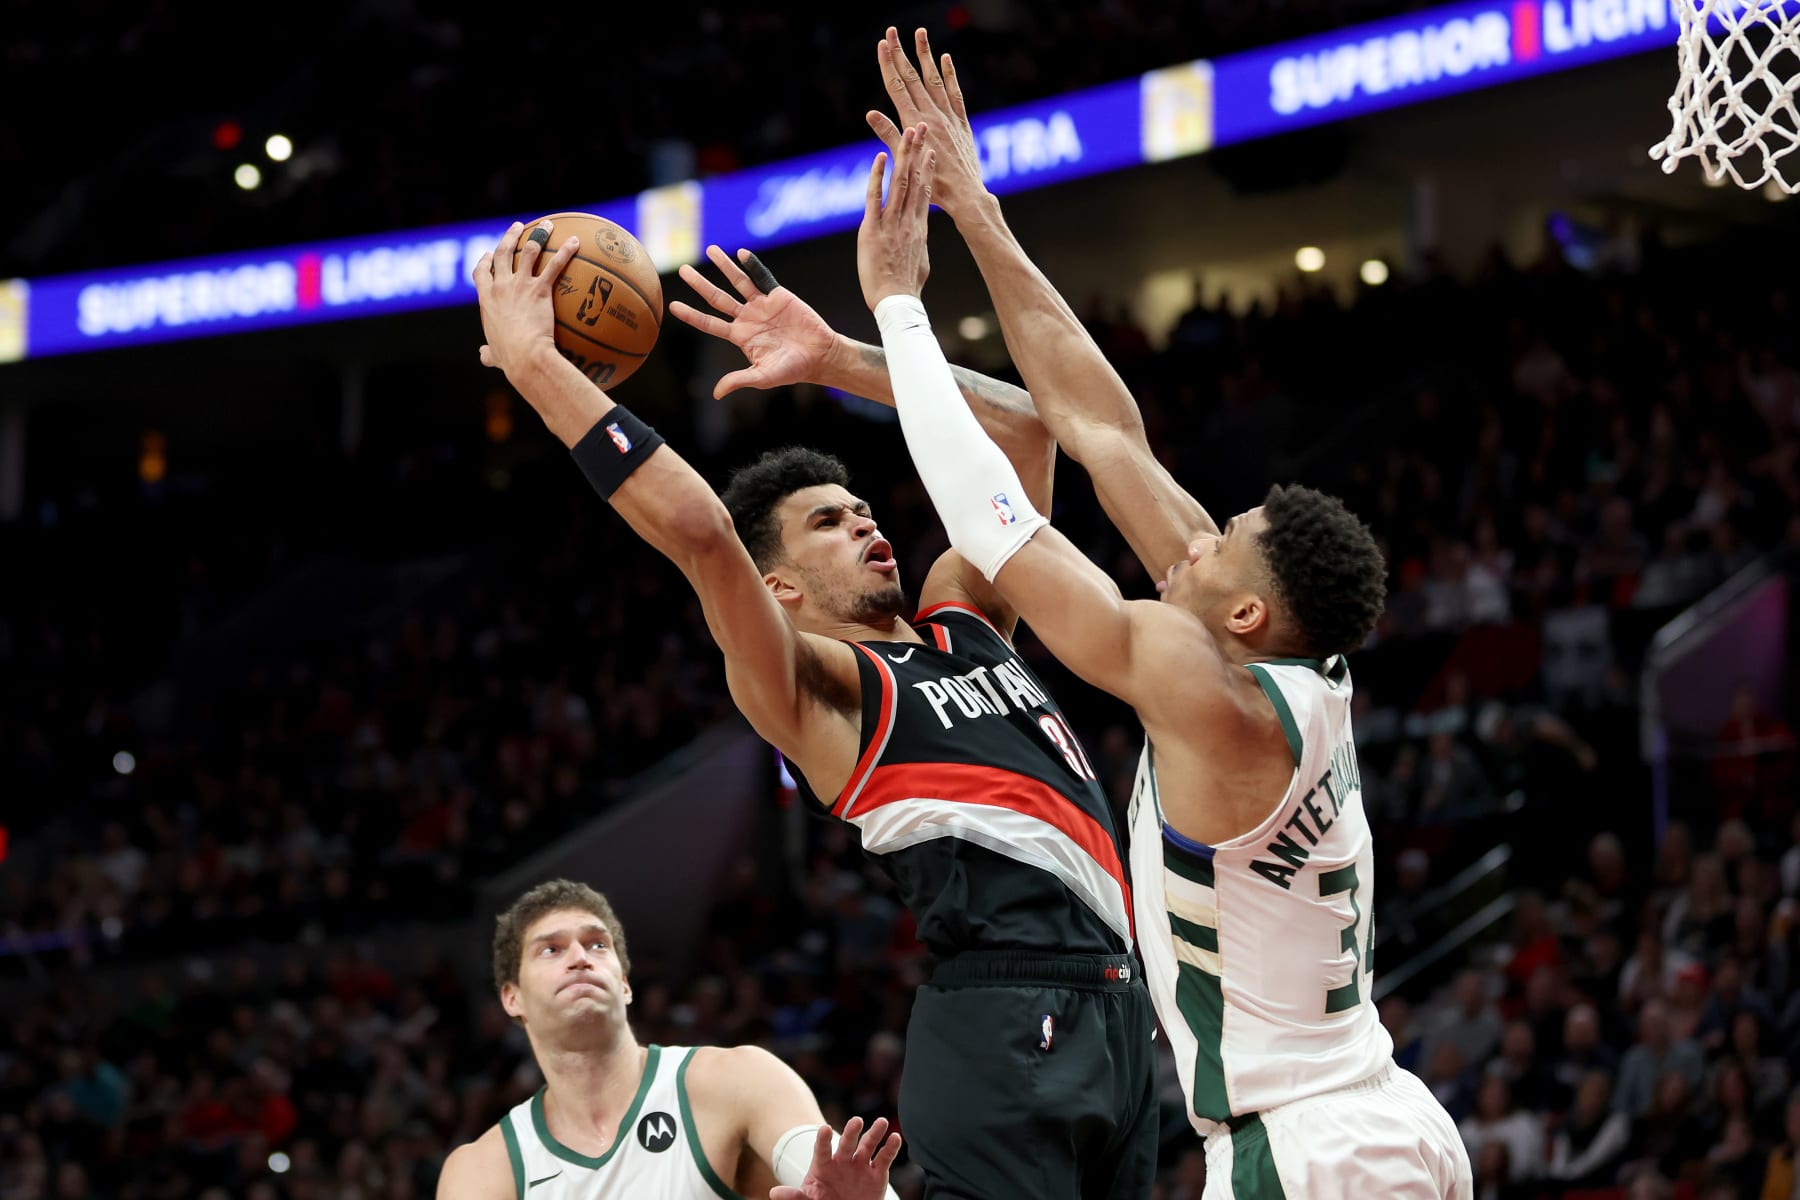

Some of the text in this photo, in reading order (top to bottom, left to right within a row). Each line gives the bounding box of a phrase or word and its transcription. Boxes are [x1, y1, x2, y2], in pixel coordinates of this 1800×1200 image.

[1270, 11, 1510, 115] SUPERIOR
[78, 260, 297, 336] SUPERIOR
[322, 239, 462, 305] LIGHT
